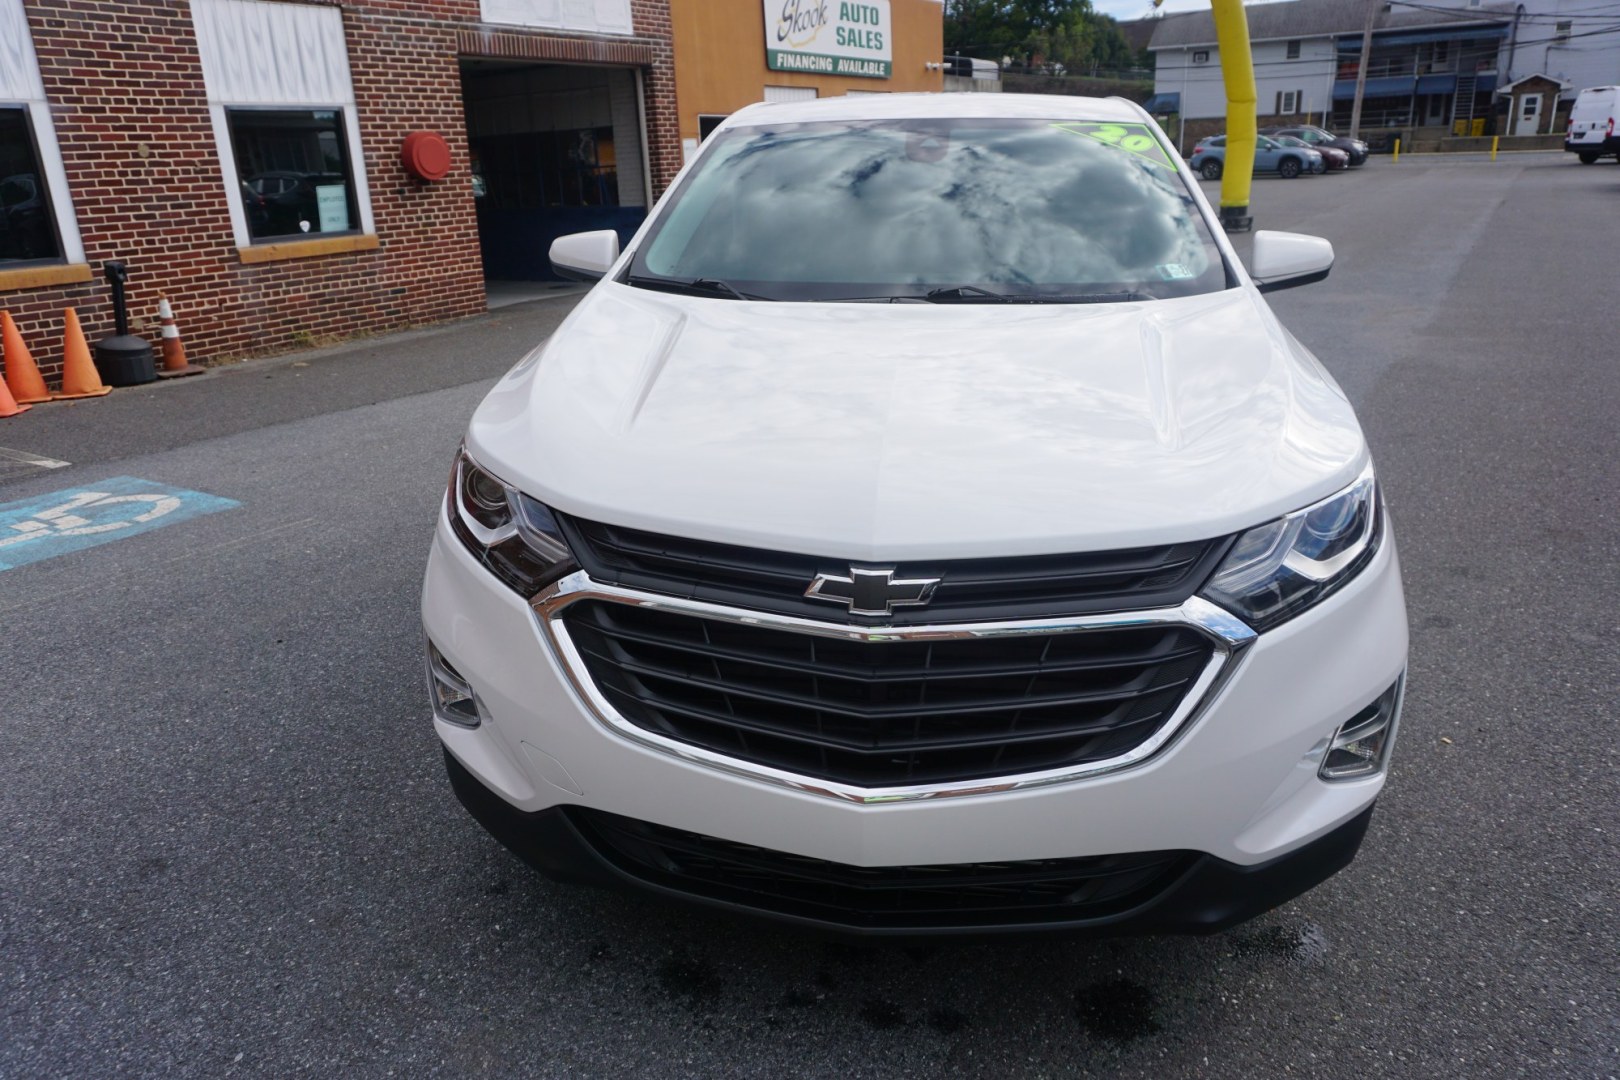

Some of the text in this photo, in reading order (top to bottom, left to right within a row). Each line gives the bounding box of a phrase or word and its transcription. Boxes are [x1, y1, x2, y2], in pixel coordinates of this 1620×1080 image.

[777, 0, 828, 42] Skook
[839, 1, 879, 26] AUTO
[836, 26, 883, 50] SALES
[777, 53, 885, 75] FINANCING AVAILABLE
